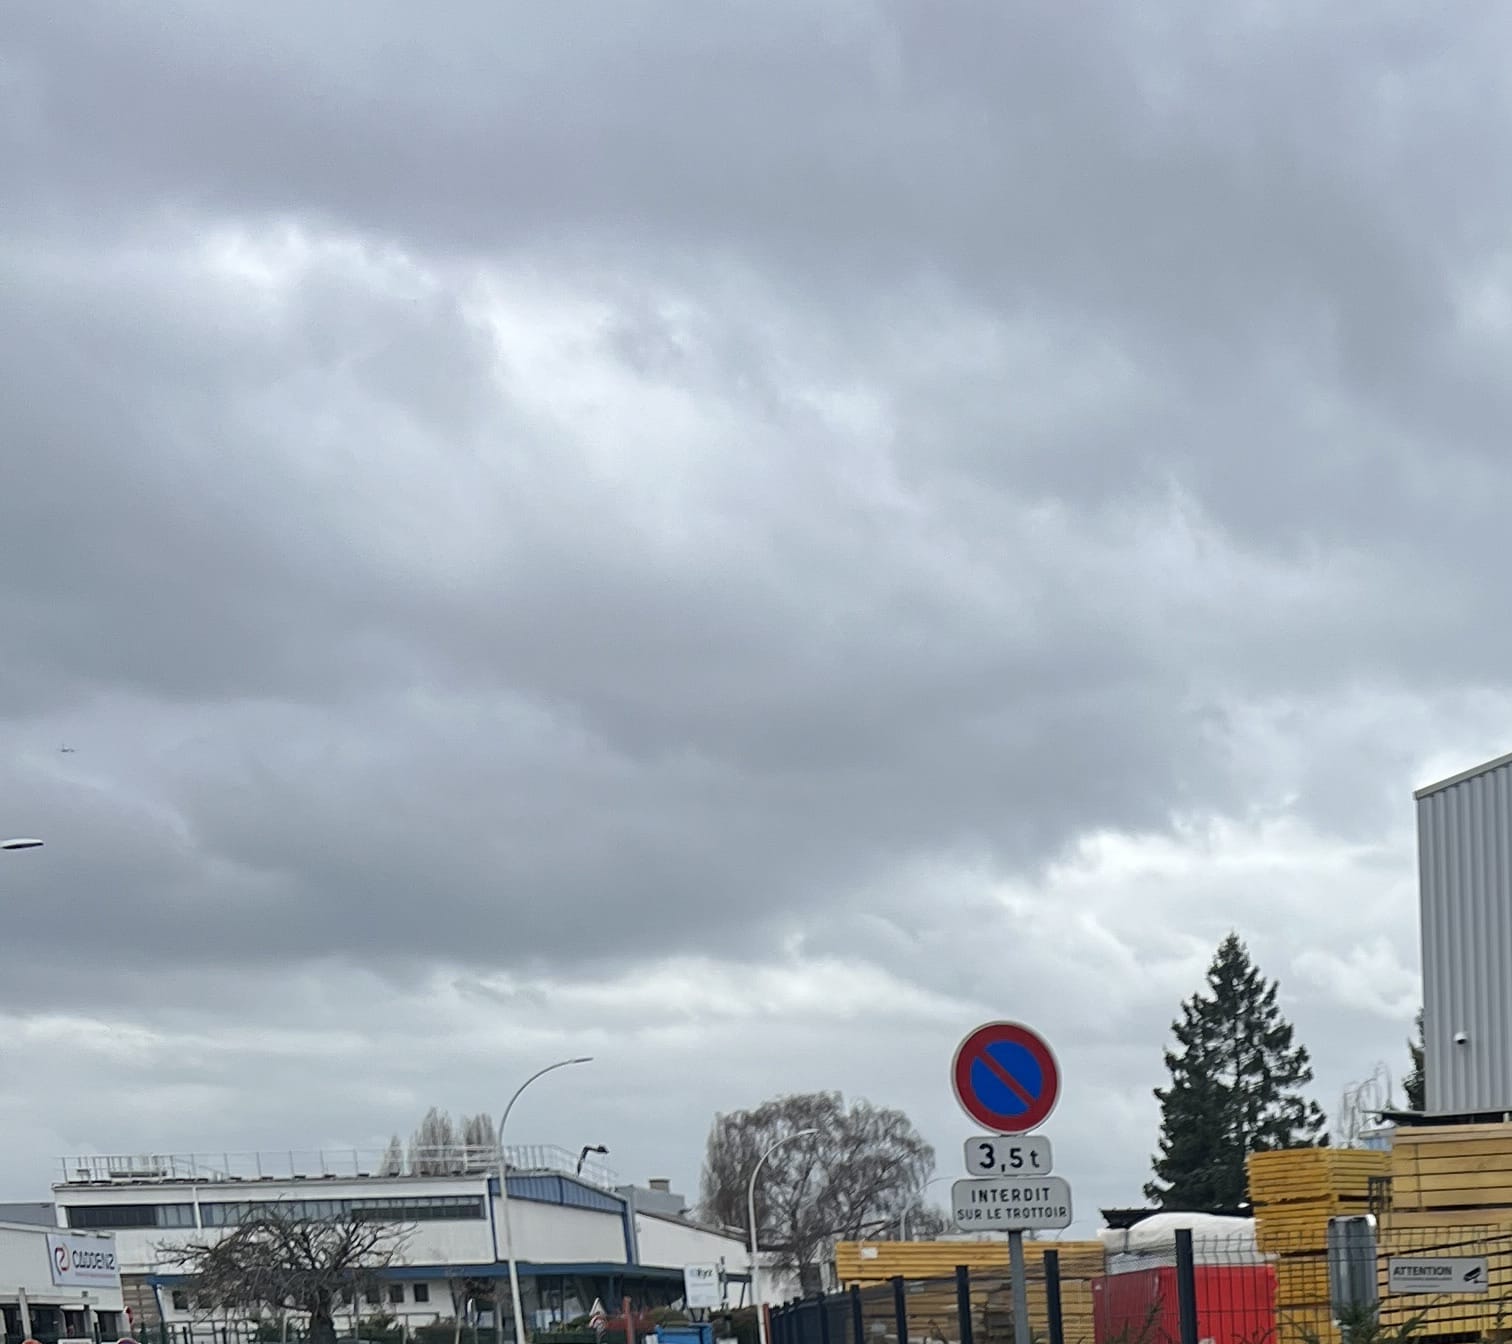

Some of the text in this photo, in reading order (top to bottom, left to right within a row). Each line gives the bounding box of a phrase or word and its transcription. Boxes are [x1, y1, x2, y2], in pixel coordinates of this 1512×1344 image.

[971, 1187, 1050, 1204] INTERDIT
[957, 1206, 1067, 1221] SUR LE TROTTOIR
[1393, 1266, 1453, 1276] ATTENTION
